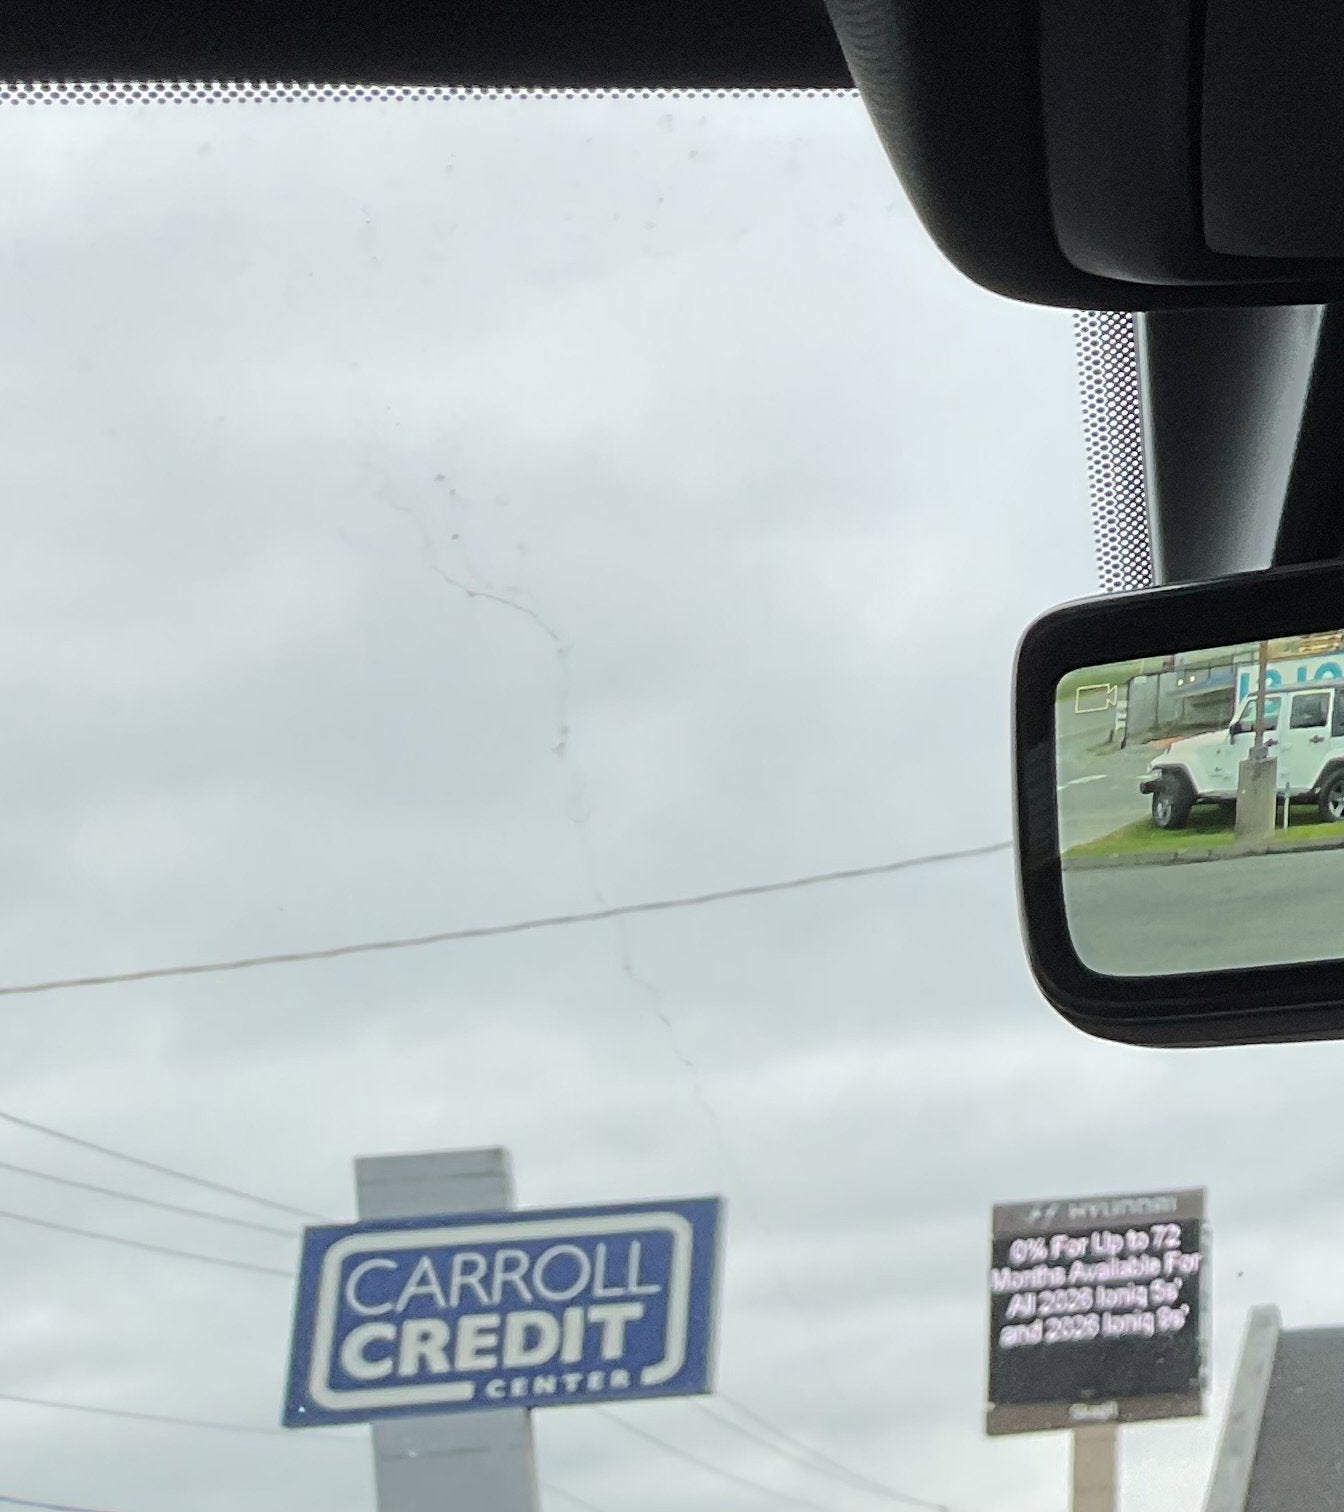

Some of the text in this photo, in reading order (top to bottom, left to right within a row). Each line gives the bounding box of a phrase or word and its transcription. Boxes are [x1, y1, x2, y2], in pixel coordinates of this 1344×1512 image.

[1068, 1196, 1177, 1219] HYUNDAI
[1009, 1223, 1181, 1266] 0% For Up to 72
[345, 1240, 662, 1315] CARROLL
[991, 1250, 1202, 1291] Months Available For
[340, 1302, 645, 1381] CREDIT
[484, 1371, 632, 1399] CENTER
